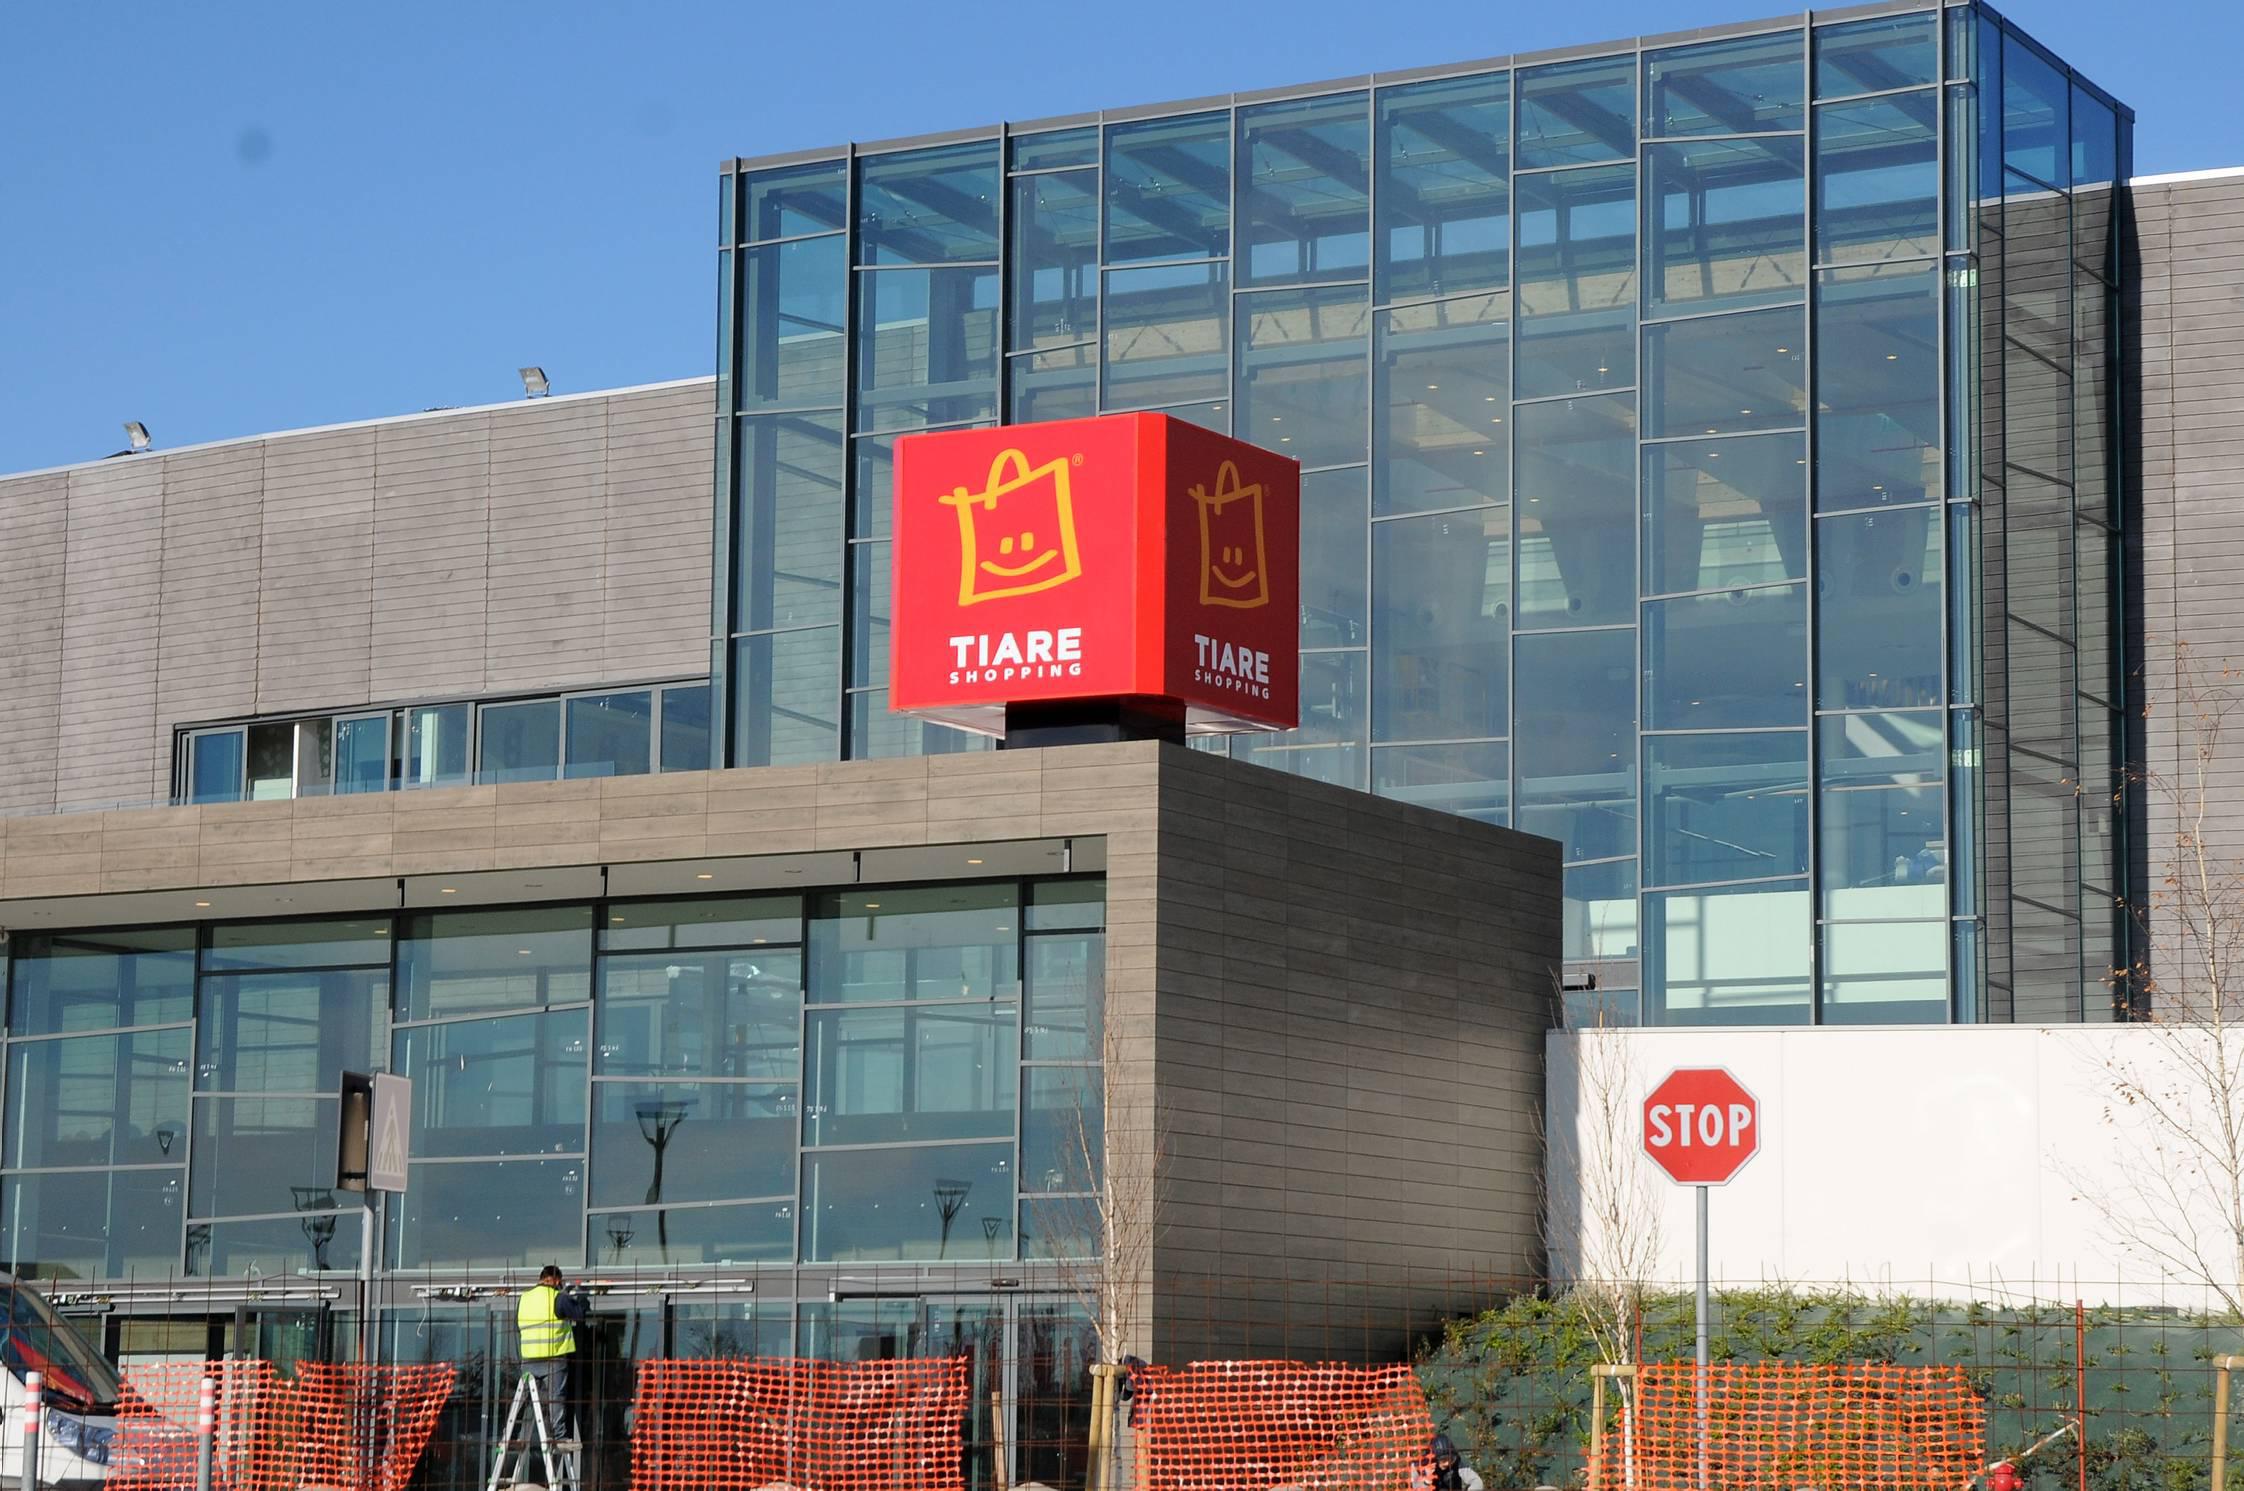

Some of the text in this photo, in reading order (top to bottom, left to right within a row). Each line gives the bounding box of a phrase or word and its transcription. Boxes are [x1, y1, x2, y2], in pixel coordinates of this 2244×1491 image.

[949, 627, 1082, 668] TIARE
[1194, 633, 1270, 685] TIARE
[949, 662, 1082, 685] SHOPPING
[1194, 669, 1270, 700] SHOPPING
[1649, 1103, 1752, 1148] STOP
